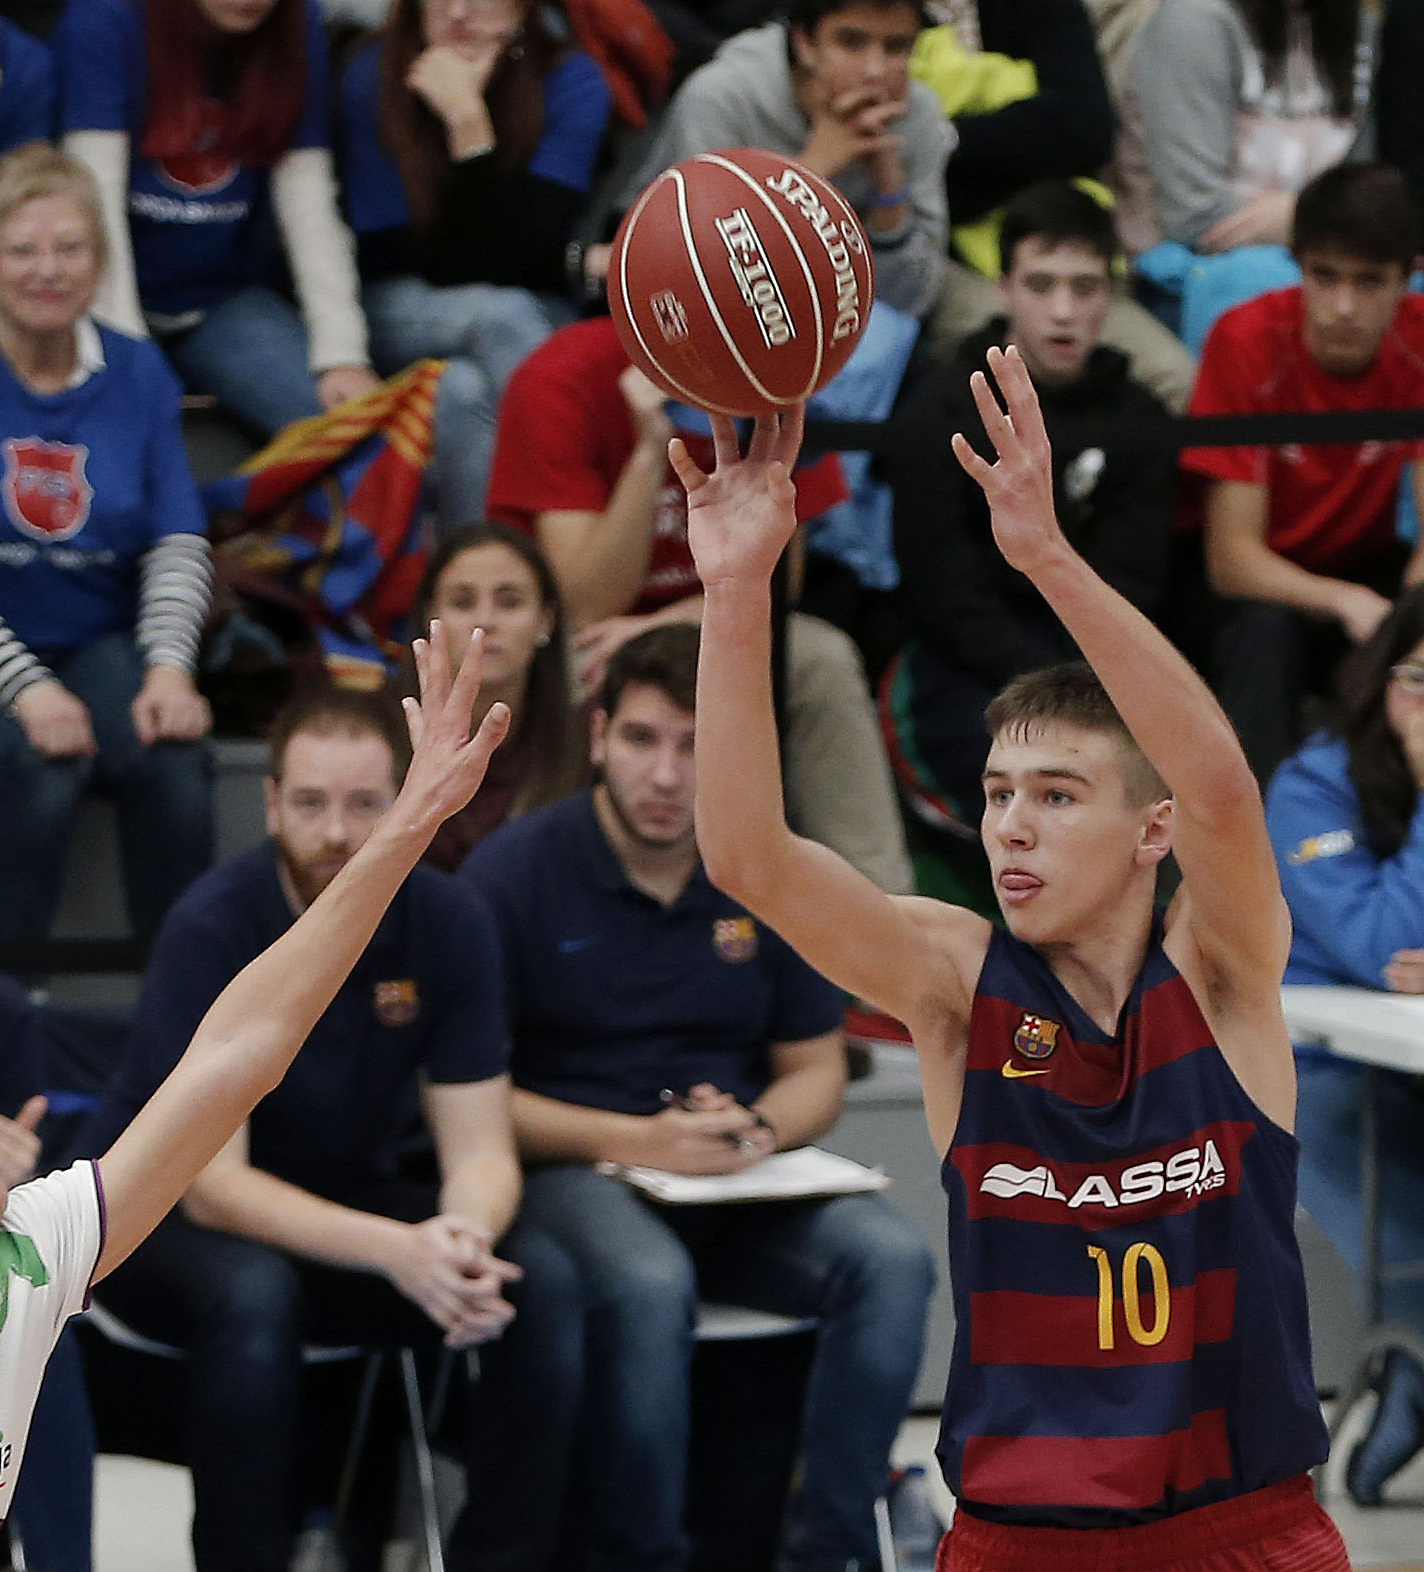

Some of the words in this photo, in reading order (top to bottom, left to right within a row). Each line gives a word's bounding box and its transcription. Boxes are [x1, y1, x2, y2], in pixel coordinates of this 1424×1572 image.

[720, 208, 791, 346] TF-1000
[765, 168, 860, 348] SPALDING
[1032, 1139, 1225, 1208] LASSA
[1087, 1242, 1171, 1350] 10
